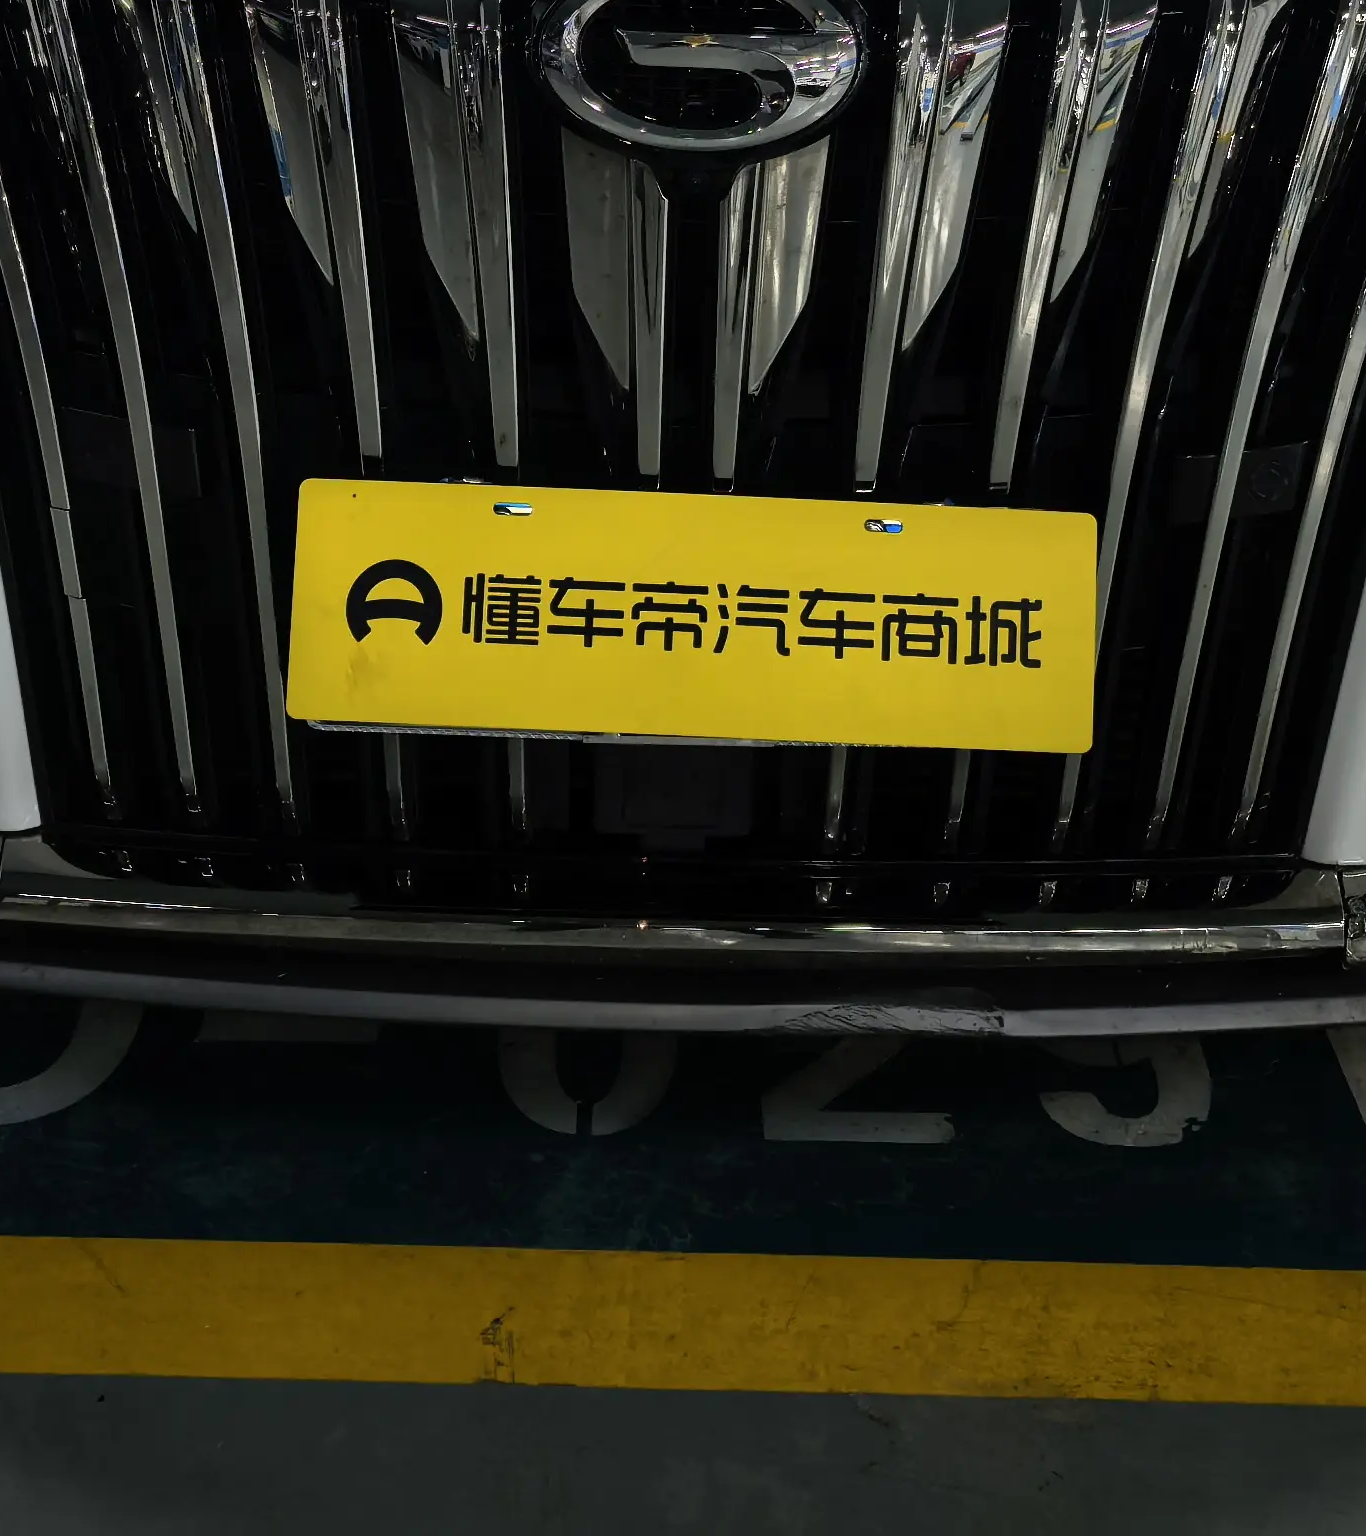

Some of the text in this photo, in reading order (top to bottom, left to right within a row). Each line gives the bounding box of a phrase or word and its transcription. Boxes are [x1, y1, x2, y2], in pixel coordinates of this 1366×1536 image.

[461, 572, 1043, 670] 懂车帝汽车商城
